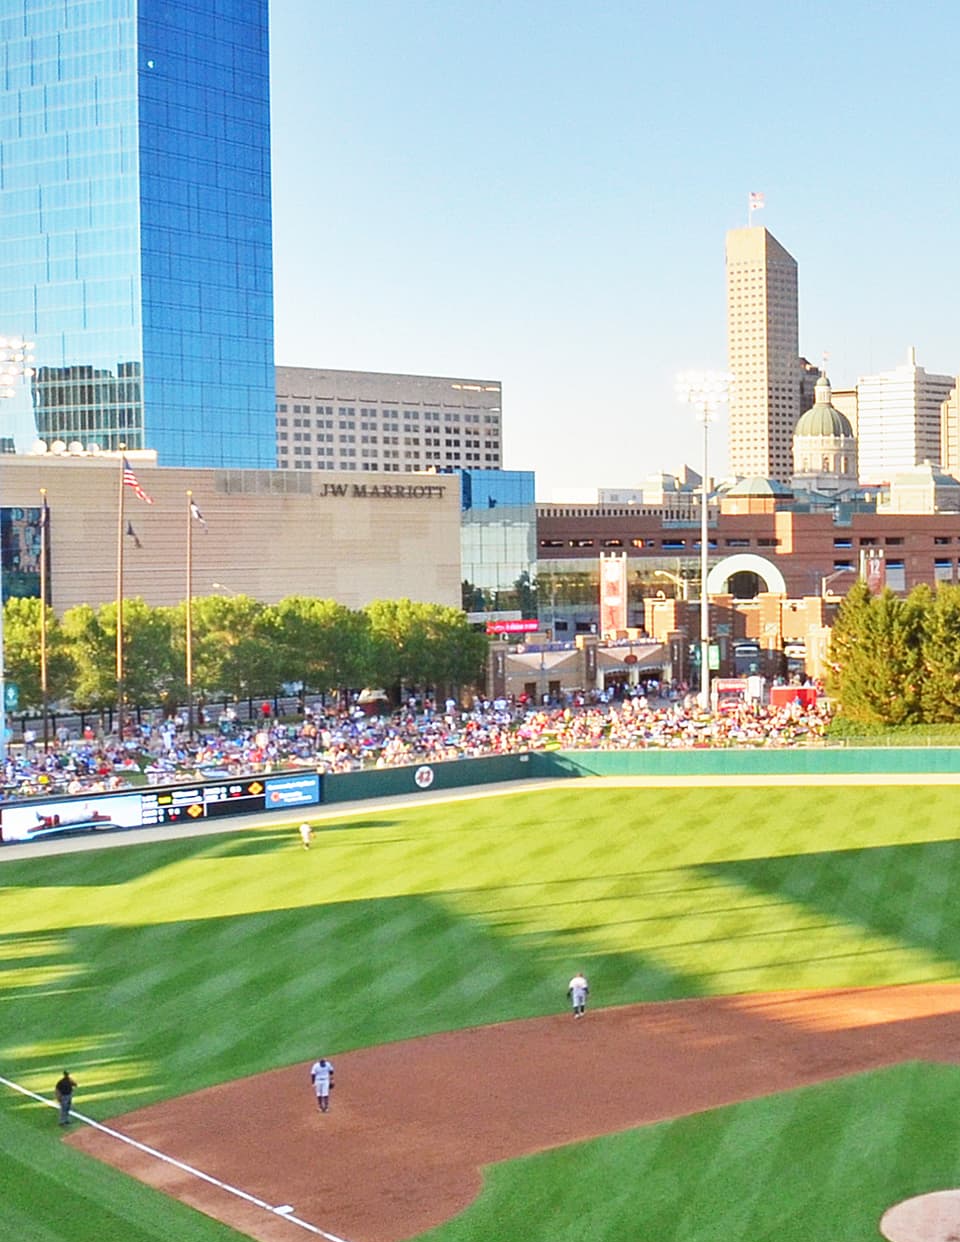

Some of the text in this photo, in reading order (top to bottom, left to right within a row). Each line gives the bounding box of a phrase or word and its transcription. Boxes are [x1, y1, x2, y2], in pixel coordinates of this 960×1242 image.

[319, 483, 447, 499] JW MARRIOTT
[869, 560, 881, 574] 12
[416, 770, 431, 783] 42
